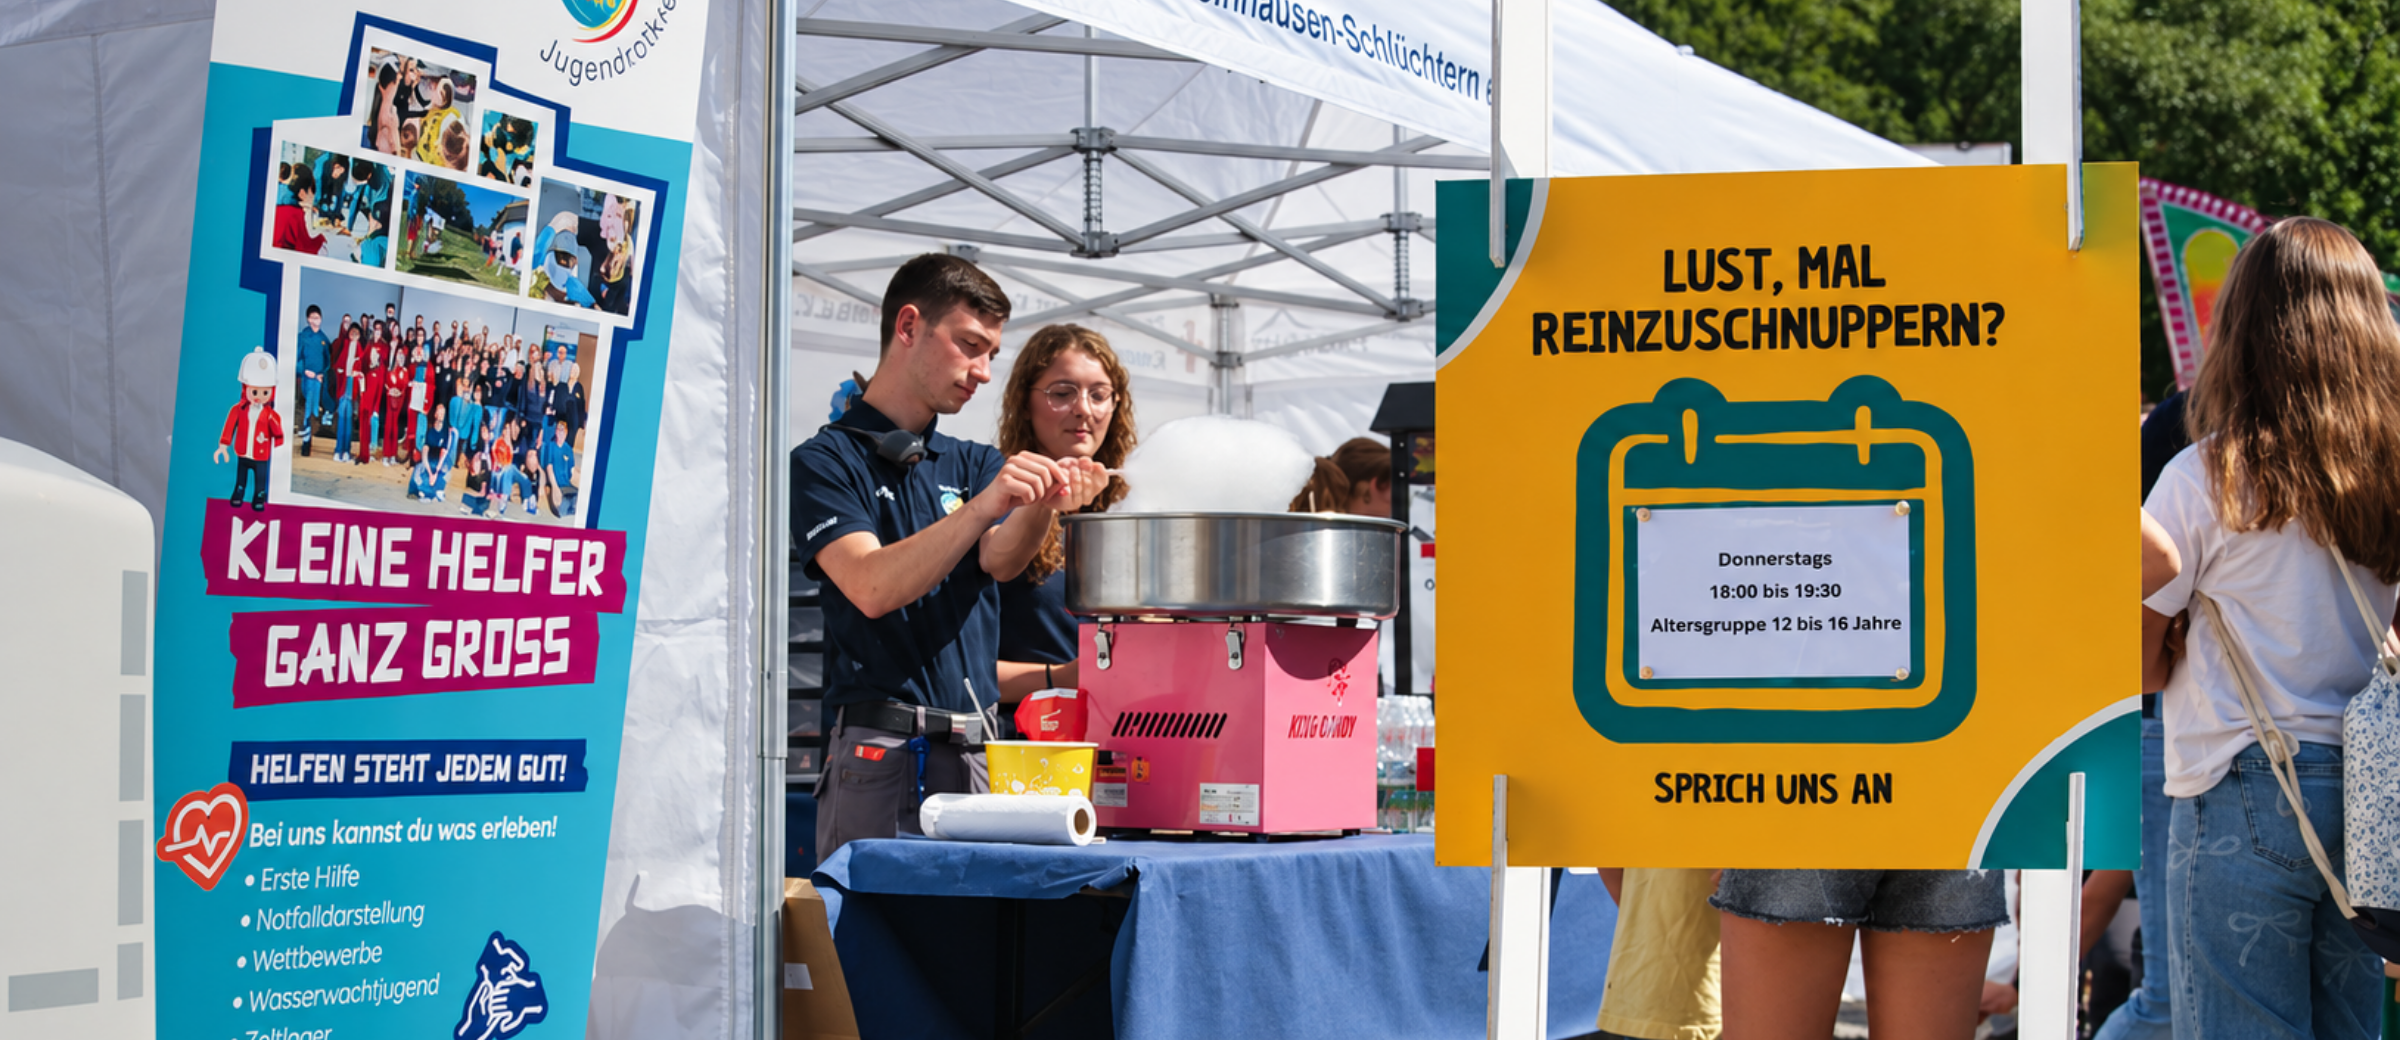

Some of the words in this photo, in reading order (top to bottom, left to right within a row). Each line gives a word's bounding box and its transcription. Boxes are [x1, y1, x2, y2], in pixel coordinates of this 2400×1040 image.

[1201, 0, 1479, 99] hausen-Schlüchtern
[1665, 248, 1782, 296] LUST,
[1799, 244, 1885, 288] MAL
[1533, 303, 2004, 355] REINZUSCHNUPPERN?
[228, 517, 412, 587] KLEINE
[429, 530, 606, 596] HELFER
[1719, 552, 1832, 569] Donnerstags
[1711, 584, 1757, 598] 18:00
[1764, 584, 1788, 598] bis
[1796, 584, 1841, 597] 19:30
[1651, 618, 1766, 635] Altersgruppe
[1773, 617, 1791, 630] 12
[1798, 617, 1822, 630] bis
[1828, 617, 1848, 630] 16
[1853, 616, 1901, 630] Jahre
[265, 622, 407, 687] GANZ
[422, 617, 569, 678] GROSS
[251, 754, 345, 783] HELFEN
[354, 754, 430, 783] STEHT
[436, 754, 511, 782] JEDEM
[518, 755, 567, 781] GUT!
[1655, 773, 1764, 803] SPRICH
[1777, 774, 1837, 804] UNS
[1852, 773, 1891, 804] AN
[250, 822, 283, 847] Bei
[288, 827, 325, 846] uns
[333, 820, 403, 844] kannst
[407, 817, 432, 842] du
[438, 822, 476, 840] was
[482, 816, 557, 839] erleben!
[261, 868, 309, 891] Erste
[315, 864, 359, 888] Hilfe
[257, 901, 425, 930] Notfalldarstellung
[254, 941, 382, 971] Wettbewerbe
[250, 973, 440, 1012] Wasserwachtjugend
